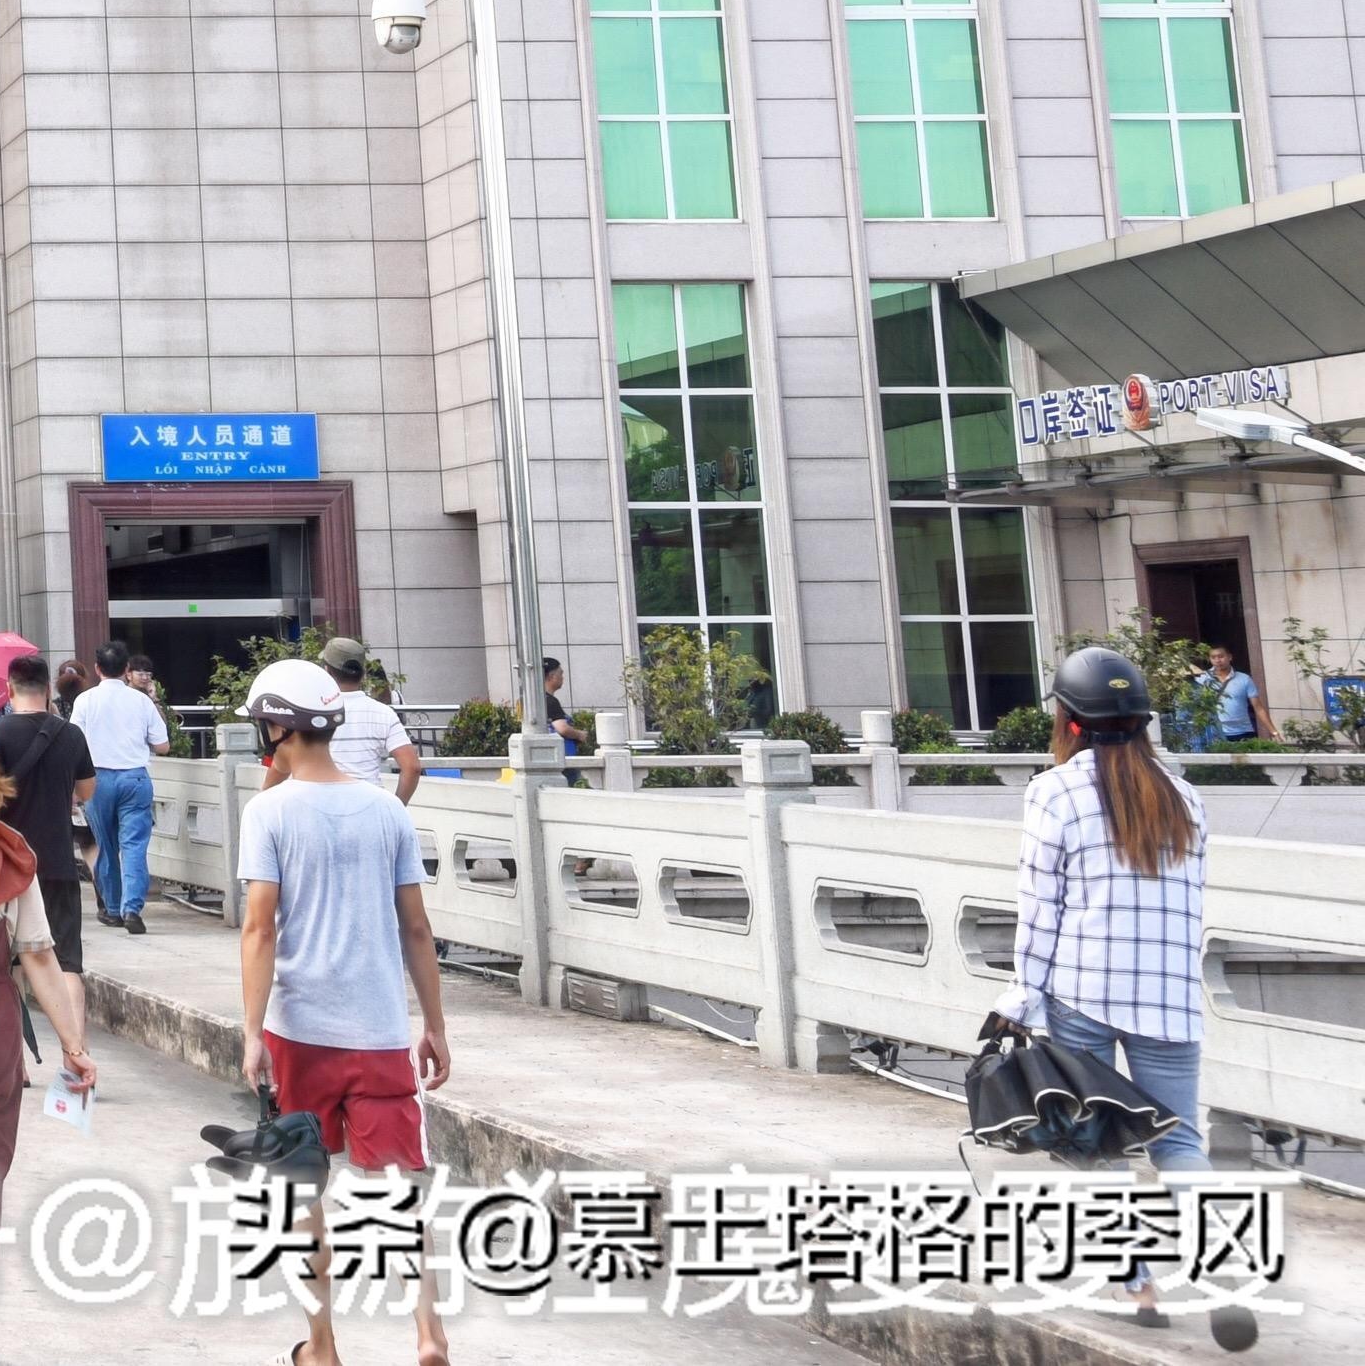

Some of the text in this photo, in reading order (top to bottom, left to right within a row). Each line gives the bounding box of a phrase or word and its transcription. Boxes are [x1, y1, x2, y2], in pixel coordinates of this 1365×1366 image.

[1159, 366, 1281, 415] PORT-VISA
[1017, 385, 1117, 445] 口岸签证
[129, 425, 293, 447] 入境人员通道
[180, 451, 251, 461] ENTRY
